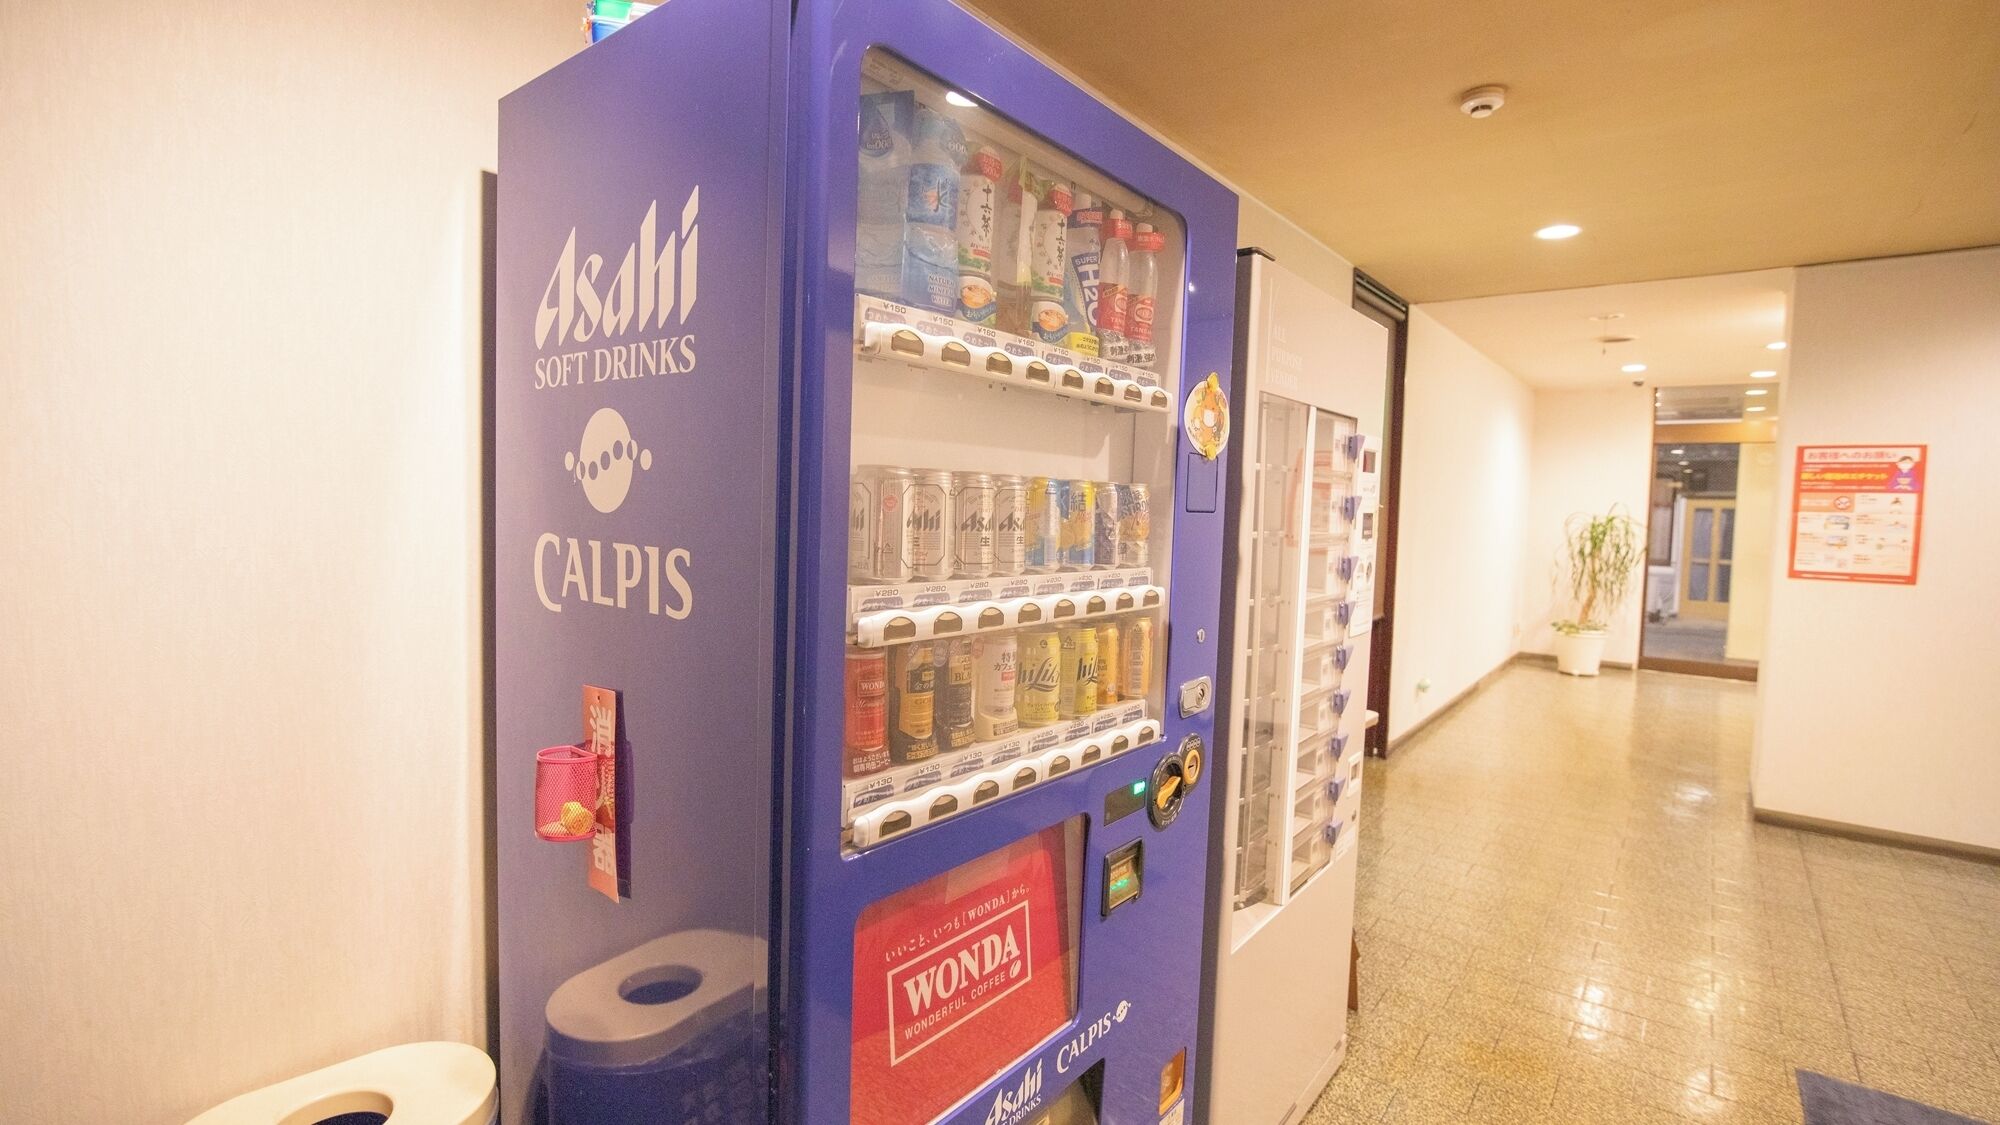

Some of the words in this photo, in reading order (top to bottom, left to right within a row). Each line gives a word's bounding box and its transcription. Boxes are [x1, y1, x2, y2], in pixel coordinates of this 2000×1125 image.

[534, 184, 699, 350] Asahi
[883, 302, 907, 314] ¥150
[933, 315, 954, 327] ¥150
[534, 351, 588, 390] SOFT
[593, 334, 696, 383] DRINKS
[534, 532, 693, 620] CALPIS
[925, 585, 947, 593] ¥280
[875, 589, 899, 597] ¥280
[919, 763, 940, 774] ¥130
[963, 751, 982, 761] ¥130
[868, 776, 893, 789] ¥130
[903, 924, 1021, 1017] WONDA
[904, 995, 967, 1040] WONDERFUL
[971, 971, 1006, 999] COFFEE
[1057, 1011, 1111, 1074] CALPIS
[984, 1058, 1042, 1125] Asahi
[1009, 1094, 1041, 1125] DRINKS
